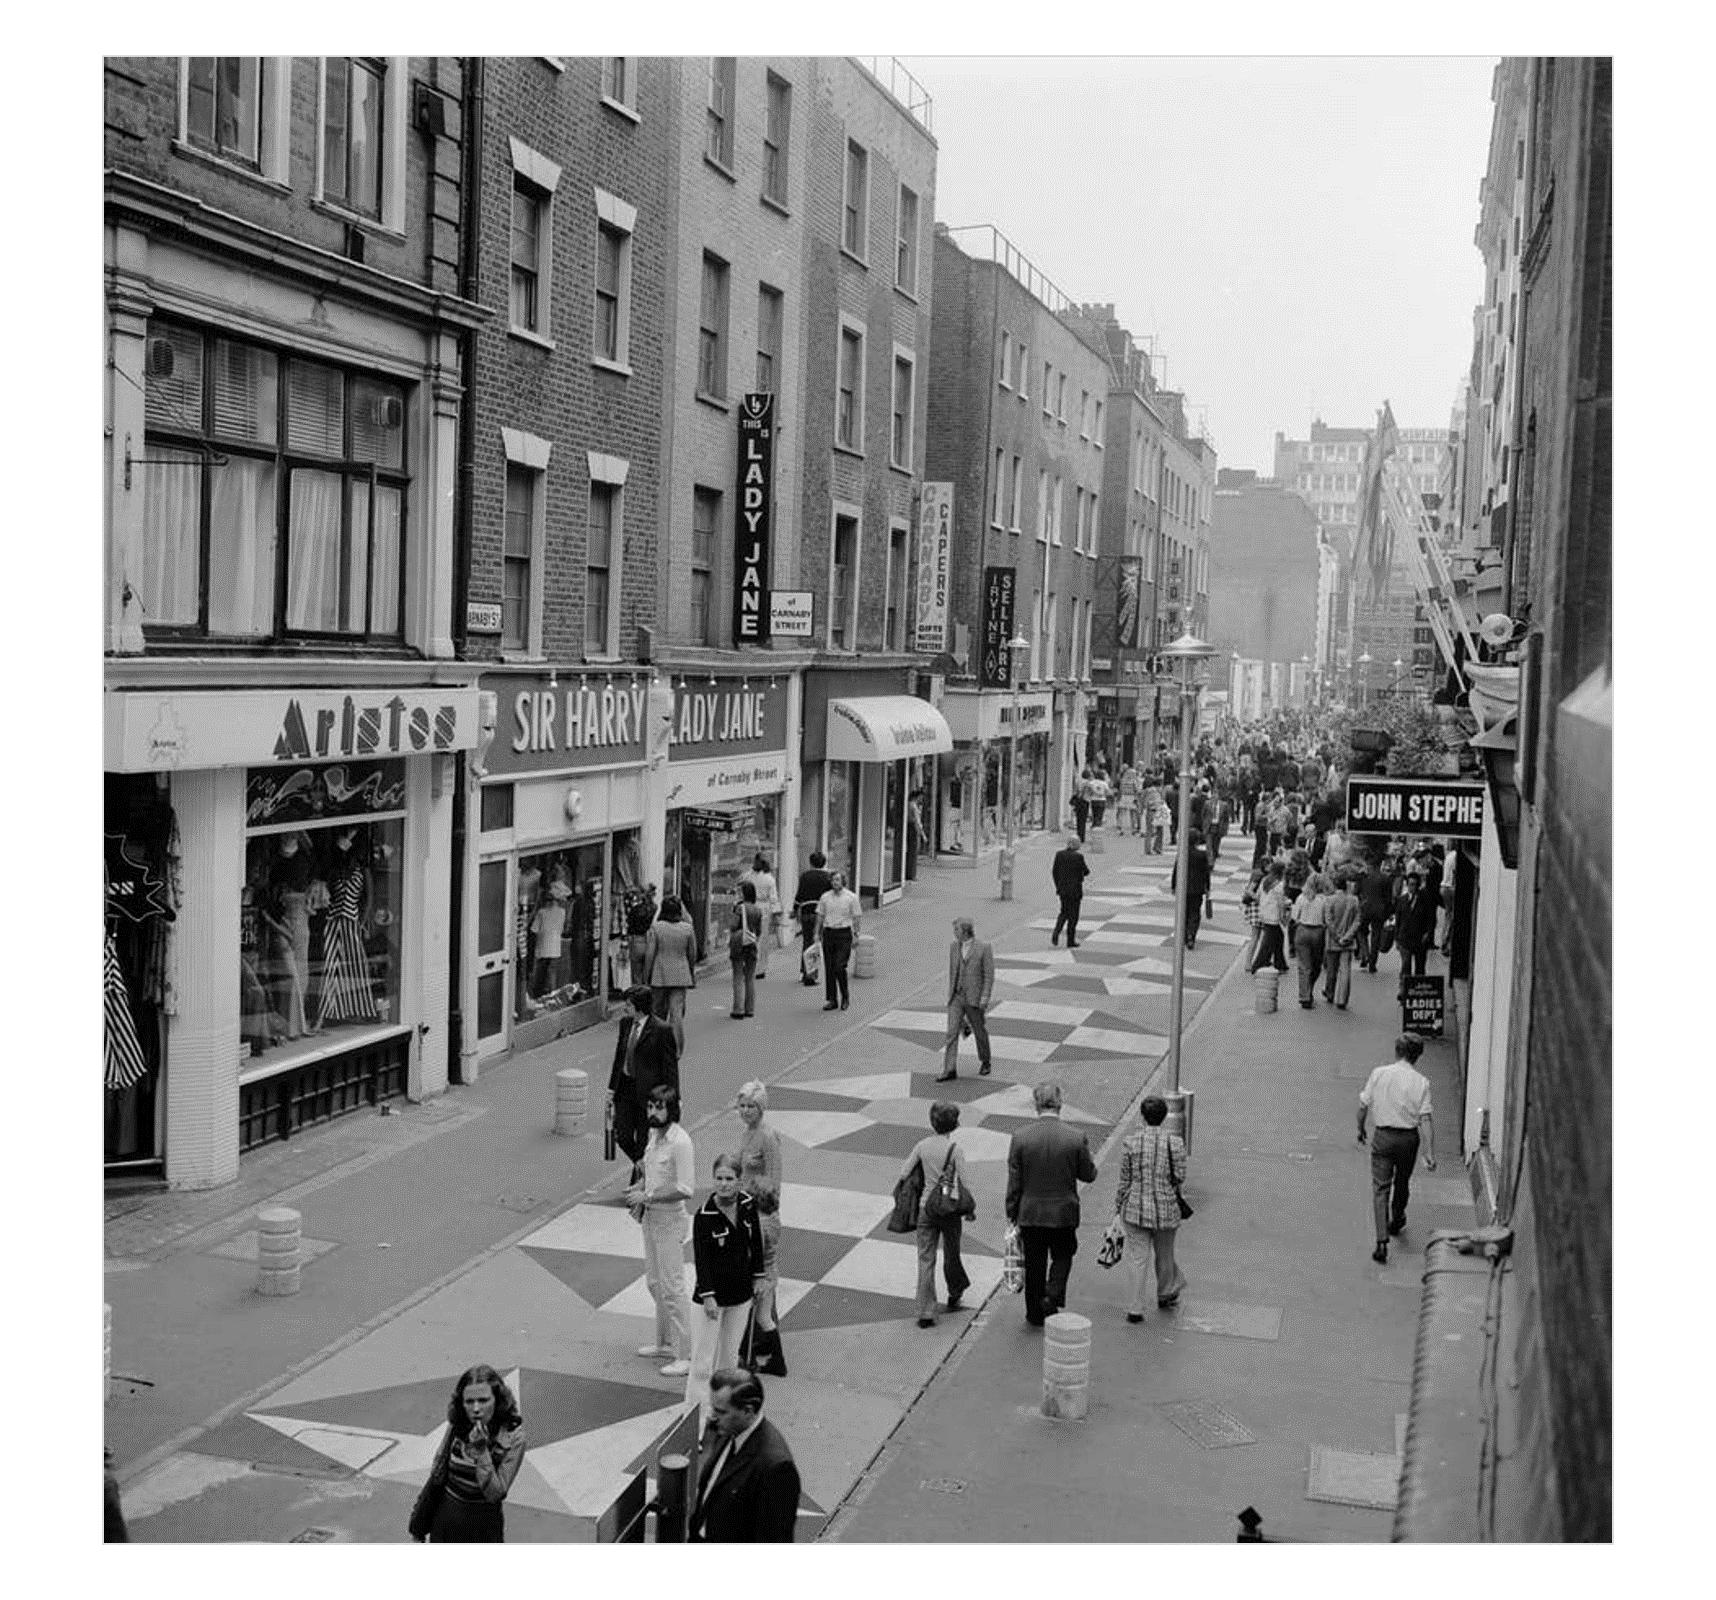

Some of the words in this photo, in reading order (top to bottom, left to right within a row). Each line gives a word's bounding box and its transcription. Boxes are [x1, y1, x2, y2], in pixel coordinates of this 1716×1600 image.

[743, 438, 765, 532] LADY
[919, 486, 937, 622] CARNABY
[936, 503, 949, 607] CAPERS
[740, 542, 761, 635] JANE
[771, 610, 811, 618] CARNABY
[988, 573, 1000, 644] IRVINE
[775, 621, 808, 630] STREET
[998, 575, 1013, 681] SELLARS
[273, 695, 457, 760] Aristos
[513, 690, 556, 752] SIR
[566, 690, 646, 748] HARRY
[720, 692, 765, 740] JANE
[718, 772, 751, 786] Carnaby
[1352, 792, 1402, 820] JOHN
[1408, 794, 1483, 824] STEPHE
[1406, 998, 1442, 1009] LADIES
[1412, 1010, 1437, 1020] DEPT
